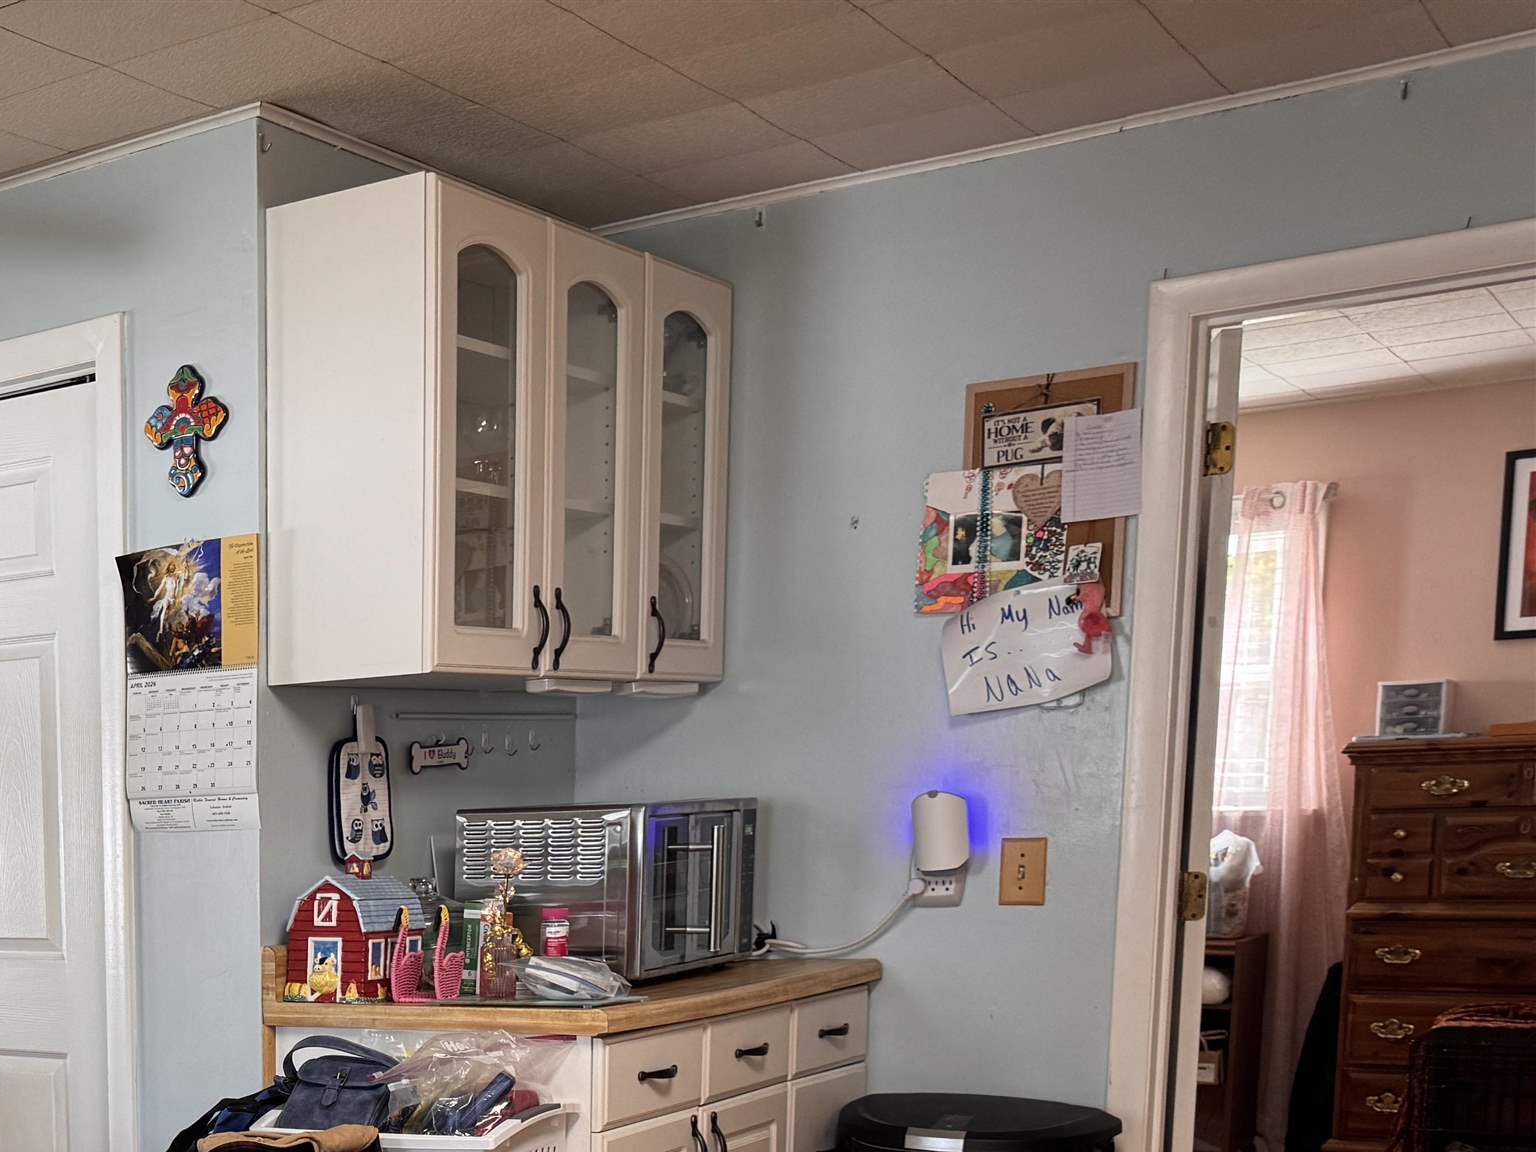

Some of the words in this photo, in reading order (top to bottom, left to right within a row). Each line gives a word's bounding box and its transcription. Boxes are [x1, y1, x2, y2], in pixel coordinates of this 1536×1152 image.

[987, 421, 1035, 439] HOME
[997, 447, 1024, 463] PUG
[960, 612, 976, 635] Hi
[1000, 603, 1029, 632] My
[1048, 594, 1084, 619] Nam
